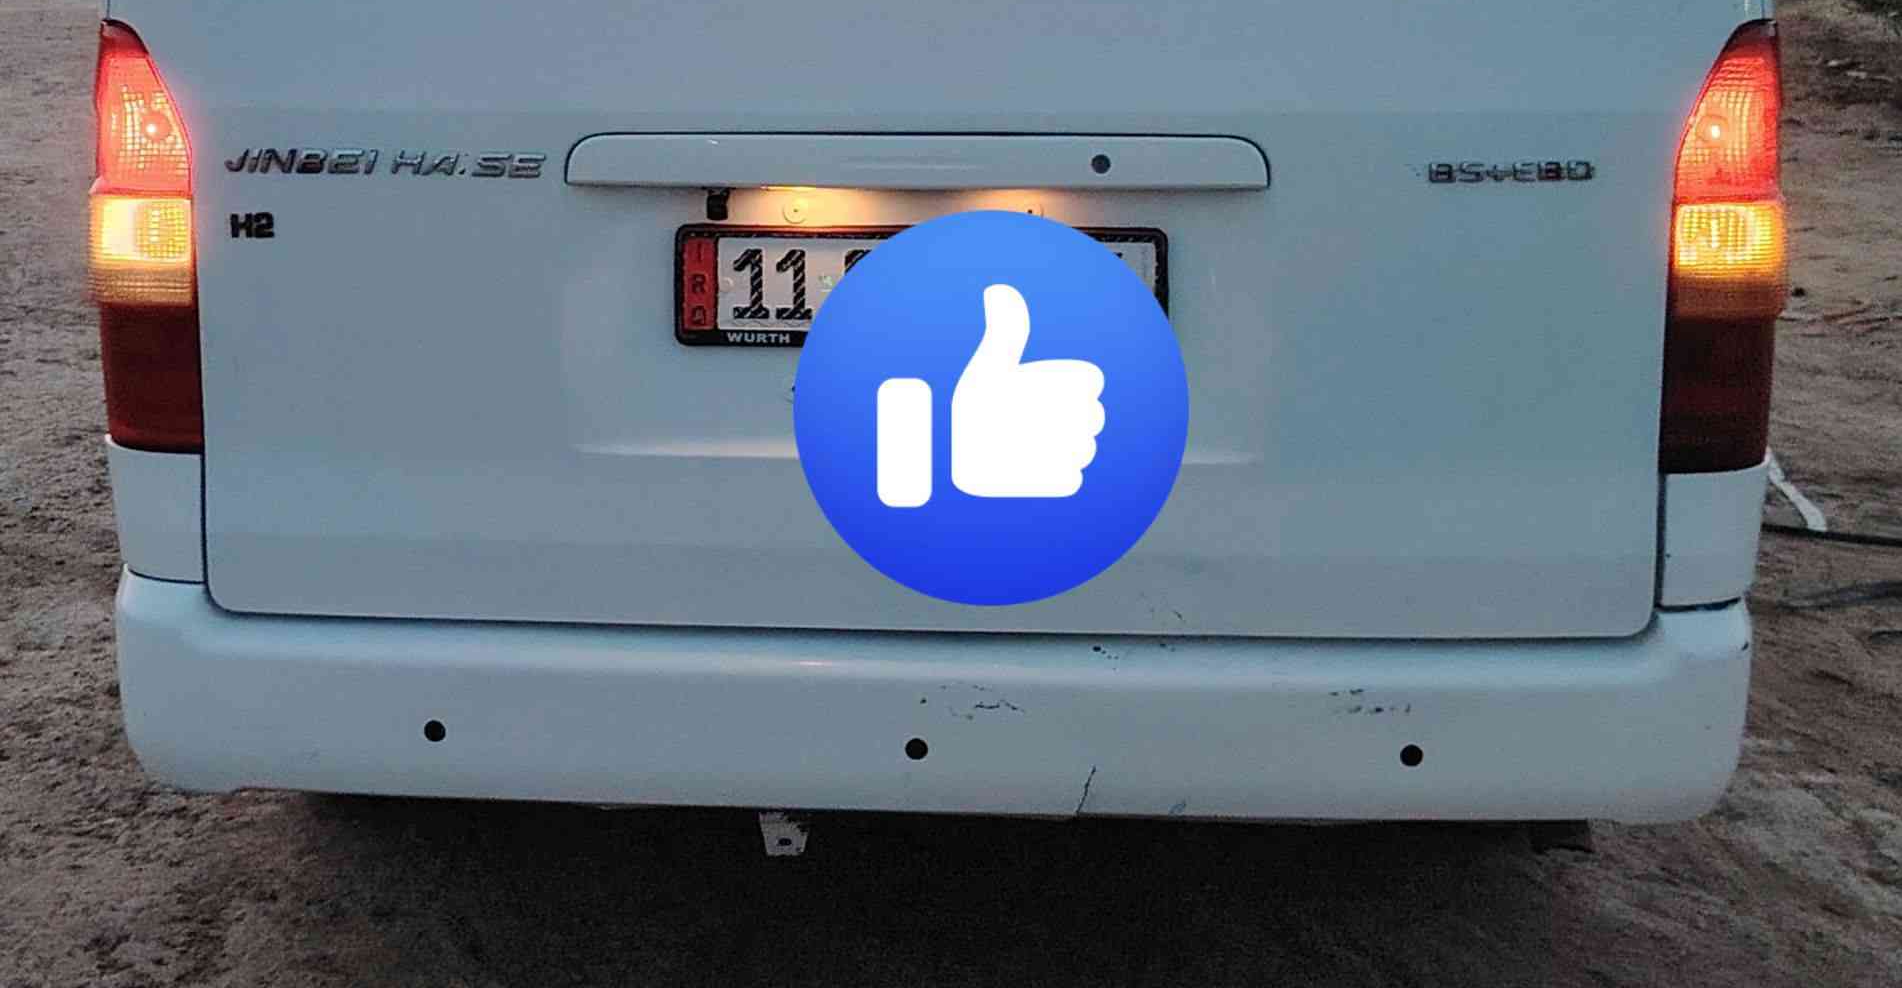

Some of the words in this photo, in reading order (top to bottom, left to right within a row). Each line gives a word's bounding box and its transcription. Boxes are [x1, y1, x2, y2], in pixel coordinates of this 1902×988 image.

[226, 148, 378, 175] JINBEI
[230, 211, 275, 239] H2
[727, 331, 791, 344] WURTH
